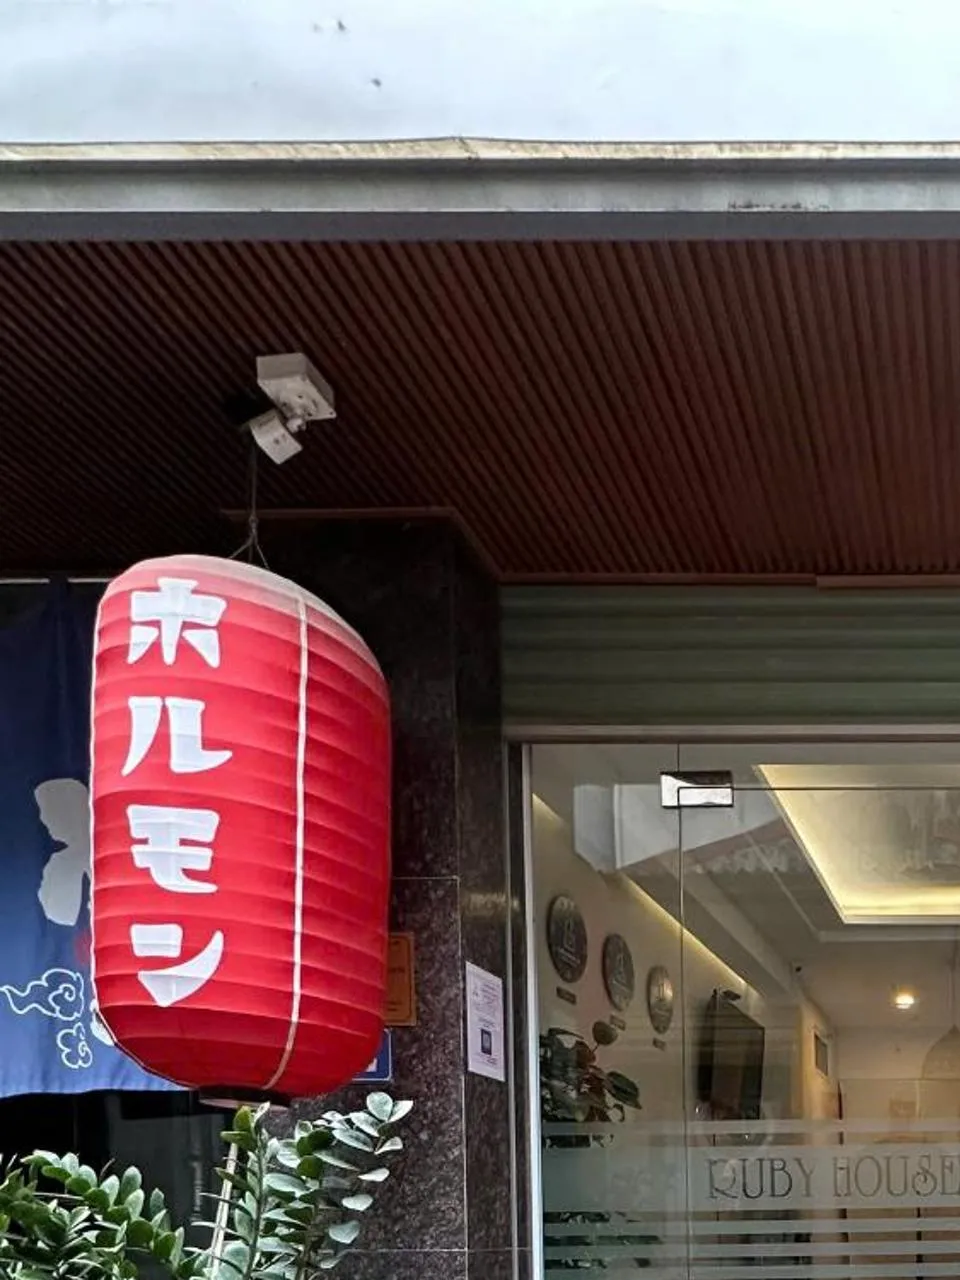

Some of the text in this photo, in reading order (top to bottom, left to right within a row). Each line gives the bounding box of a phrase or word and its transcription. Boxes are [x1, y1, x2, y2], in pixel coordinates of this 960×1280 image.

[122, 577, 232, 1007] ホルモン
[707, 1156, 815, 1199] RUBY
